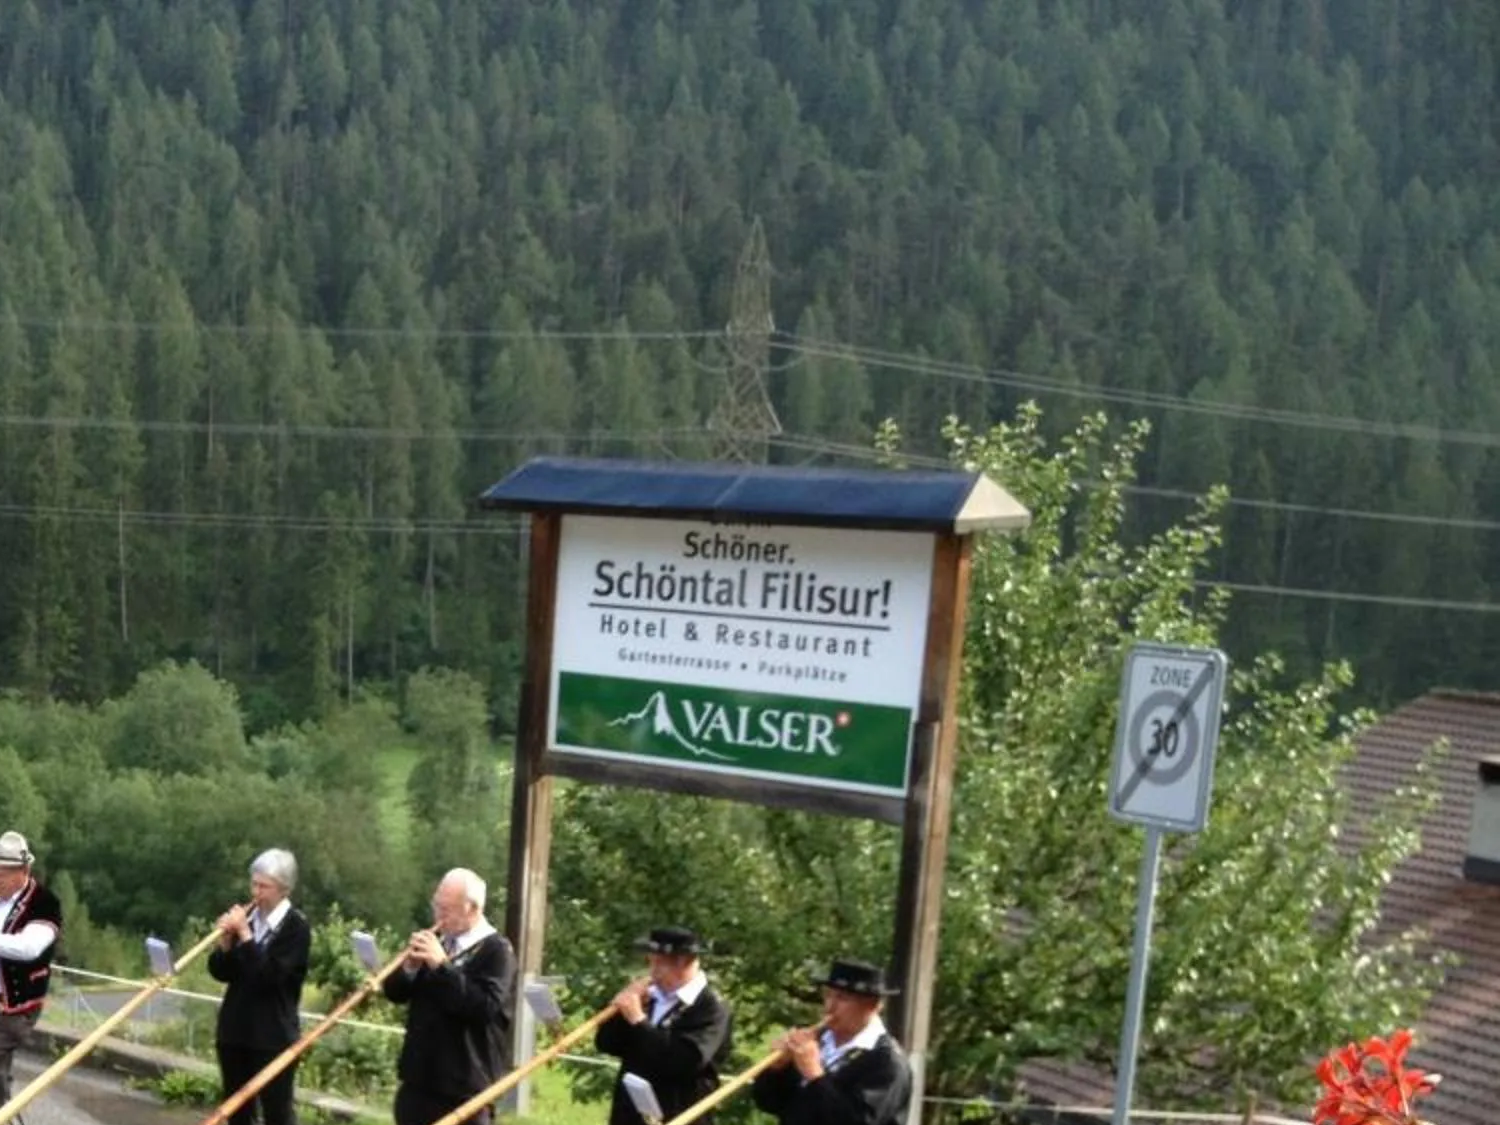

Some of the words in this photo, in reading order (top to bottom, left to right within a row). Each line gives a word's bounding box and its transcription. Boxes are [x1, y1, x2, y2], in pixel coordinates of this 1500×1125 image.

[683, 530, 796, 565] Schöner.
[593, 560, 748, 608] Schöntal
[761, 571, 892, 619] Filisur!
[600, 613, 667, 640] Hotel
[684, 621, 698, 642] &
[715, 623, 872, 657] Restaurant
[1150, 665, 1193, 689] ZONE
[681, 699, 841, 756] VALSER
[1148, 718, 1179, 758] 30
